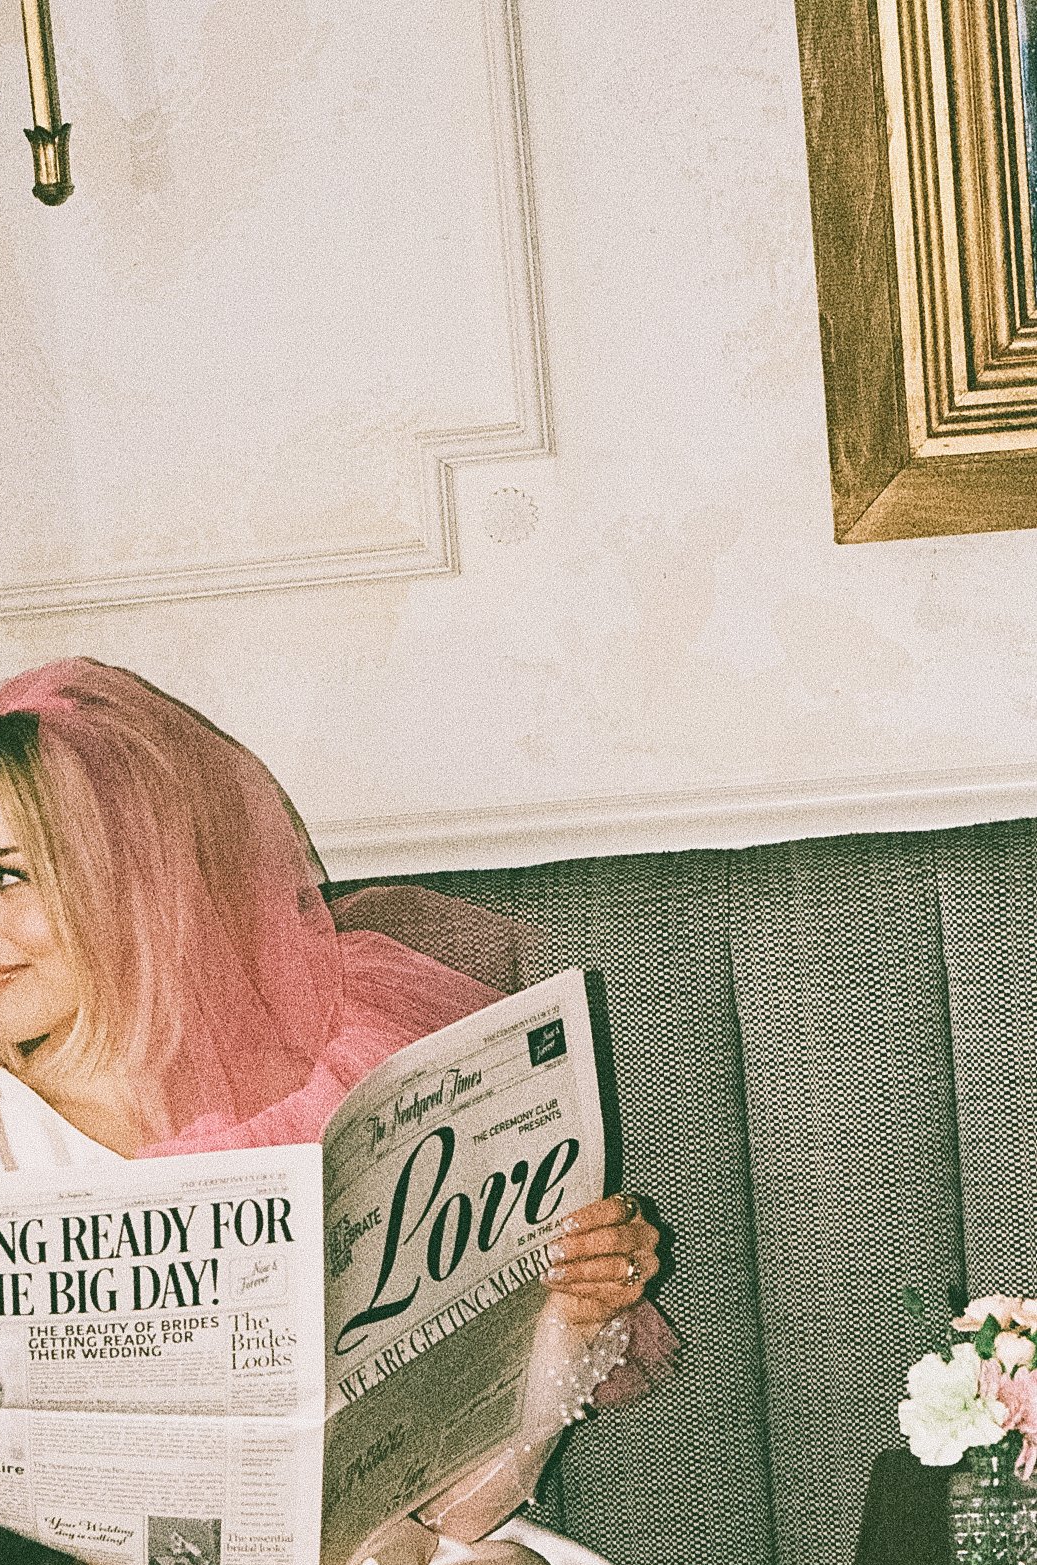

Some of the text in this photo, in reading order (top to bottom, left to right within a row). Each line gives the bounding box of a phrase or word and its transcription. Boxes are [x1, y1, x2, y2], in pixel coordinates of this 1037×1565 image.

[444, 1068, 483, 1105] Times
[472, 1098, 558, 1146] THE CEREMONY CLUB
[518, 1108, 562, 1136] PRESENTS
[60, 1204, 199, 1263] READY
[211, 1197, 296, 1250] FOR
[334, 1126, 579, 1356] Love
[518, 1236, 526, 1246] IS
[527, 1230, 536, 1241] IN
[537, 1222, 553, 1236] THE
[48, 1267, 118, 1315] BIG
[130, 1258, 220, 1311] DAY!
[28, 1317, 220, 1337] THE BEAUTY OF BRIDES
[228, 1312, 270, 1333] The
[337, 1364, 370, 1402] WE
[373, 1338, 413, 1382] ARE
[409, 1283, 493, 1354] GETTING
[488, 1244, 554, 1300] MARRI
[28, 1331, 194, 1349] GETTING READY FOR
[231, 1327, 297, 1351] Bride's
[29, 1346, 162, 1361] THEIR WEDDING
[231, 1349, 293, 1371] Looks
[44, 1515, 135, 1537] Your Wedding
[55, 1529, 75, 1540] day
[226, 1543, 286, 1554] bridal looks
[227, 1533, 294, 1544] The essential
